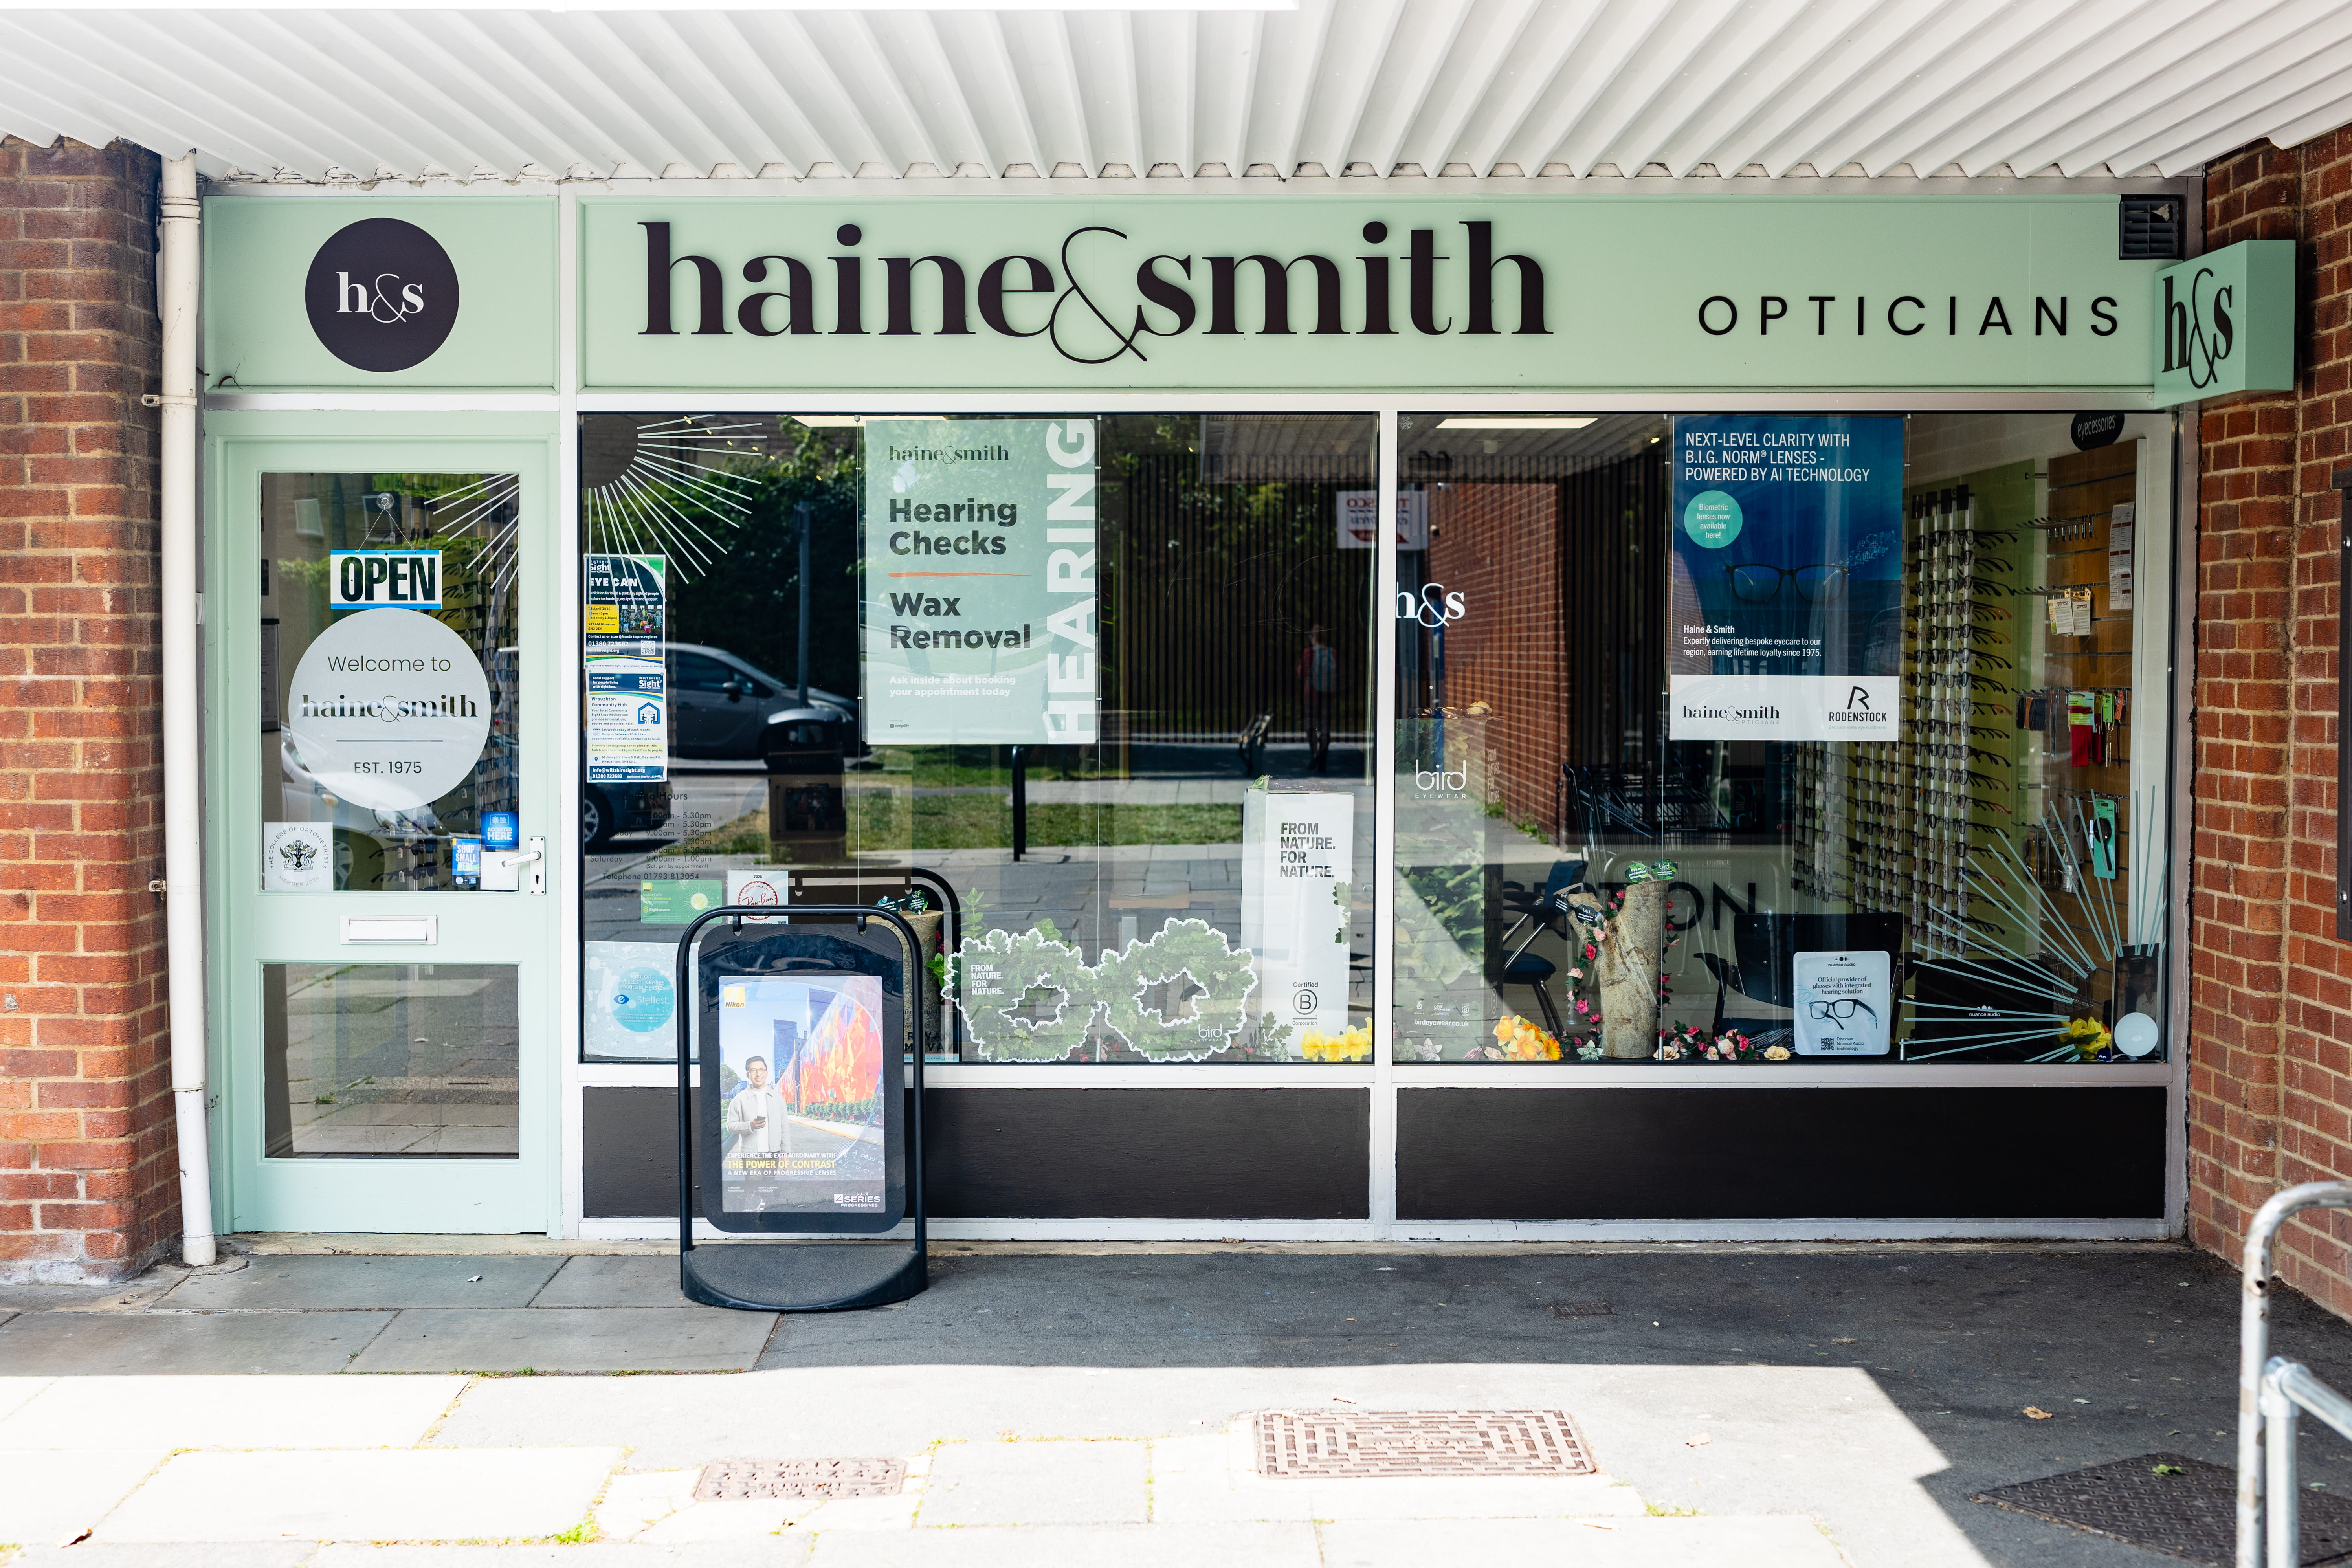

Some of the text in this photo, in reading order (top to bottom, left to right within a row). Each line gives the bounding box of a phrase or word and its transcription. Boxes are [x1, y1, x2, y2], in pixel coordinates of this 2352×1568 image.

[336, 272, 424, 323] h&s
[637, 221, 1554, 364] haine&smith
[1699, 296, 2117, 336] OPTICIANS
[2162, 268, 2233, 388] h&s
[1686, 433, 1849, 446] NEXT-LEVEL CLARITY WITH
[889, 445, 1009, 464] haine&smith
[1686, 450, 1718, 463] B.I.G.
[1771, 451, 1816, 464] LENSES
[1686, 468, 1869, 481] POWERED BY AI TECHNOLOGY
[890, 498, 1016, 527] Hearing
[890, 530, 1006, 555] Checks
[340, 556, 435, 602] OPEN
[613, 578, 637, 587] CAN
[1046, 419, 1096, 744] HEARING
[890, 593, 961, 616] Wax
[891, 624, 1030, 649] Removal
[1684, 637, 1710, 646] Expertly
[1712, 637, 1743, 646] delivering
[1745, 637, 1772, 646] bespoke
[1684, 648, 1705, 657] region,
[1708, 648, 1732, 657] earning
[1760, 649, 1781, 657] loyalty
[328, 656, 450, 671] Welcome to
[975, 676, 1016, 685] booking
[890, 688, 1011, 697] your appointment today
[302, 695, 477, 722] haine&smith
[1683, 706, 1779, 721] haine&smith
[1829, 712, 1886, 722] RODENSTOCK
[355, 761, 421, 773] EST. 1975
[1415, 759, 1466, 791] bird
[1281, 823, 1318, 834] FROM
[487, 831, 512, 840] HERE
[269, 830, 287, 854] COLLEGE
[300, 827, 328, 869] OPTOMETRISTS
[457, 845, 475, 853] SHOP
[1281, 837, 1335, 849] NATURE.
[456, 853, 476, 862] SMALL
[1281, 851, 1306, 863] FOR
[458, 862, 473, 871] HERE
[1281, 866, 1334, 877] NATURE.
[637, 996, 668, 1004] Stellest
[1299, 995, 1311, 1010] B
[1198, 1024, 1222, 1038] bird
[728, 1160, 835, 1168] THE POWER OF CONTRAST
